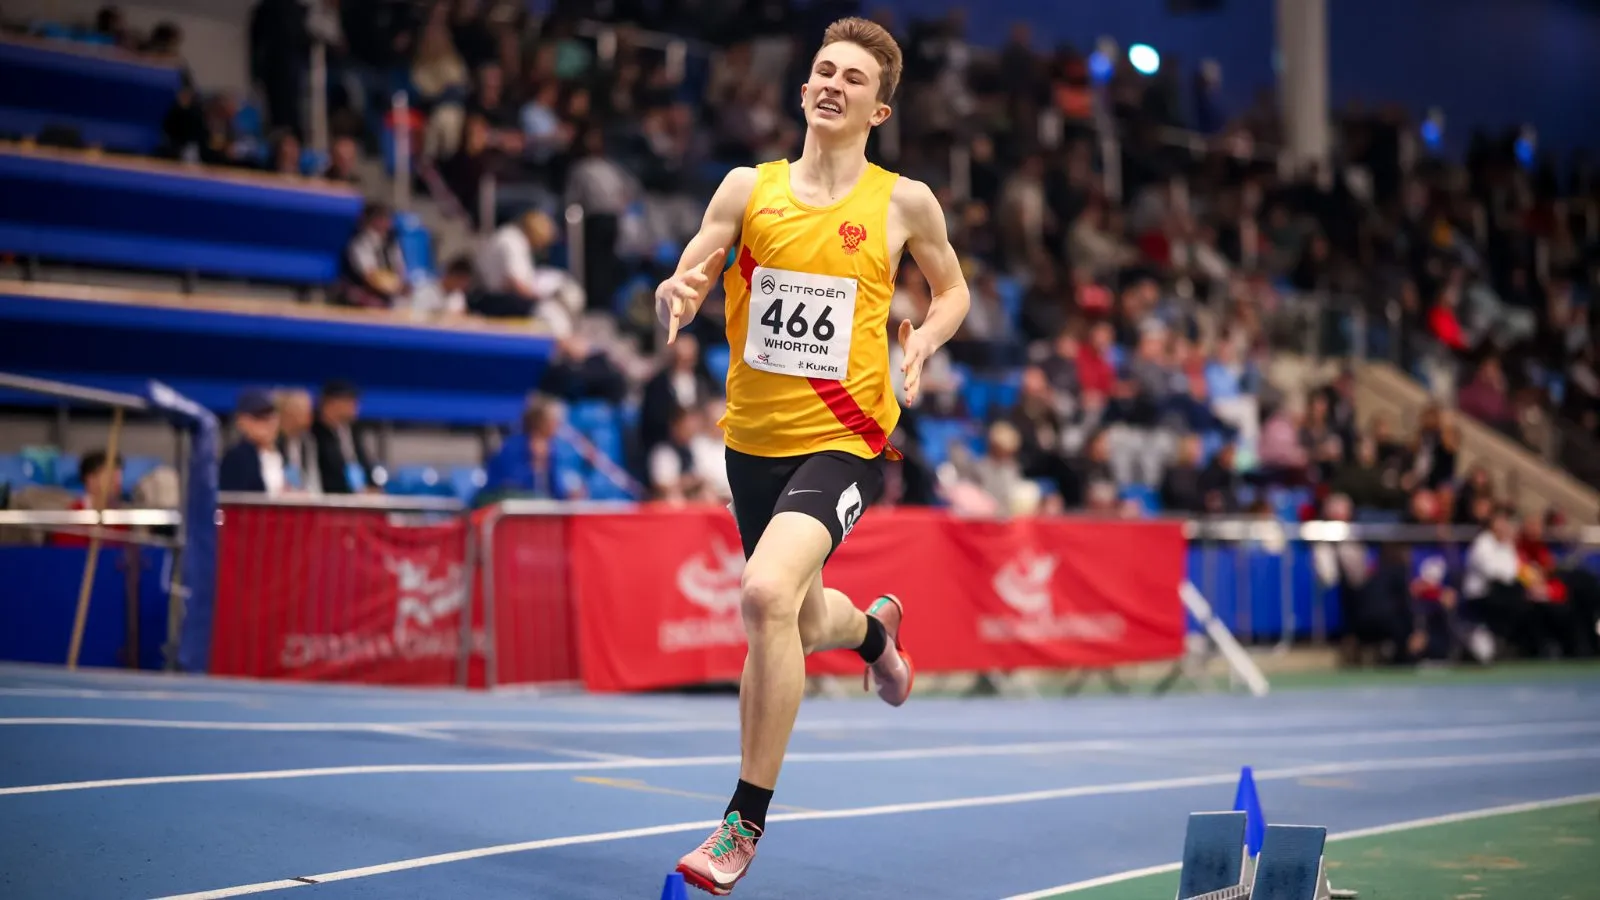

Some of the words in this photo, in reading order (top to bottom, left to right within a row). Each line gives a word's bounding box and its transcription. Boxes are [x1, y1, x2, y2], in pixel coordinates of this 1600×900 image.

[779, 284, 846, 299] CITROËN
[760, 298, 835, 342] 466
[764, 337, 829, 355] WHORTON
